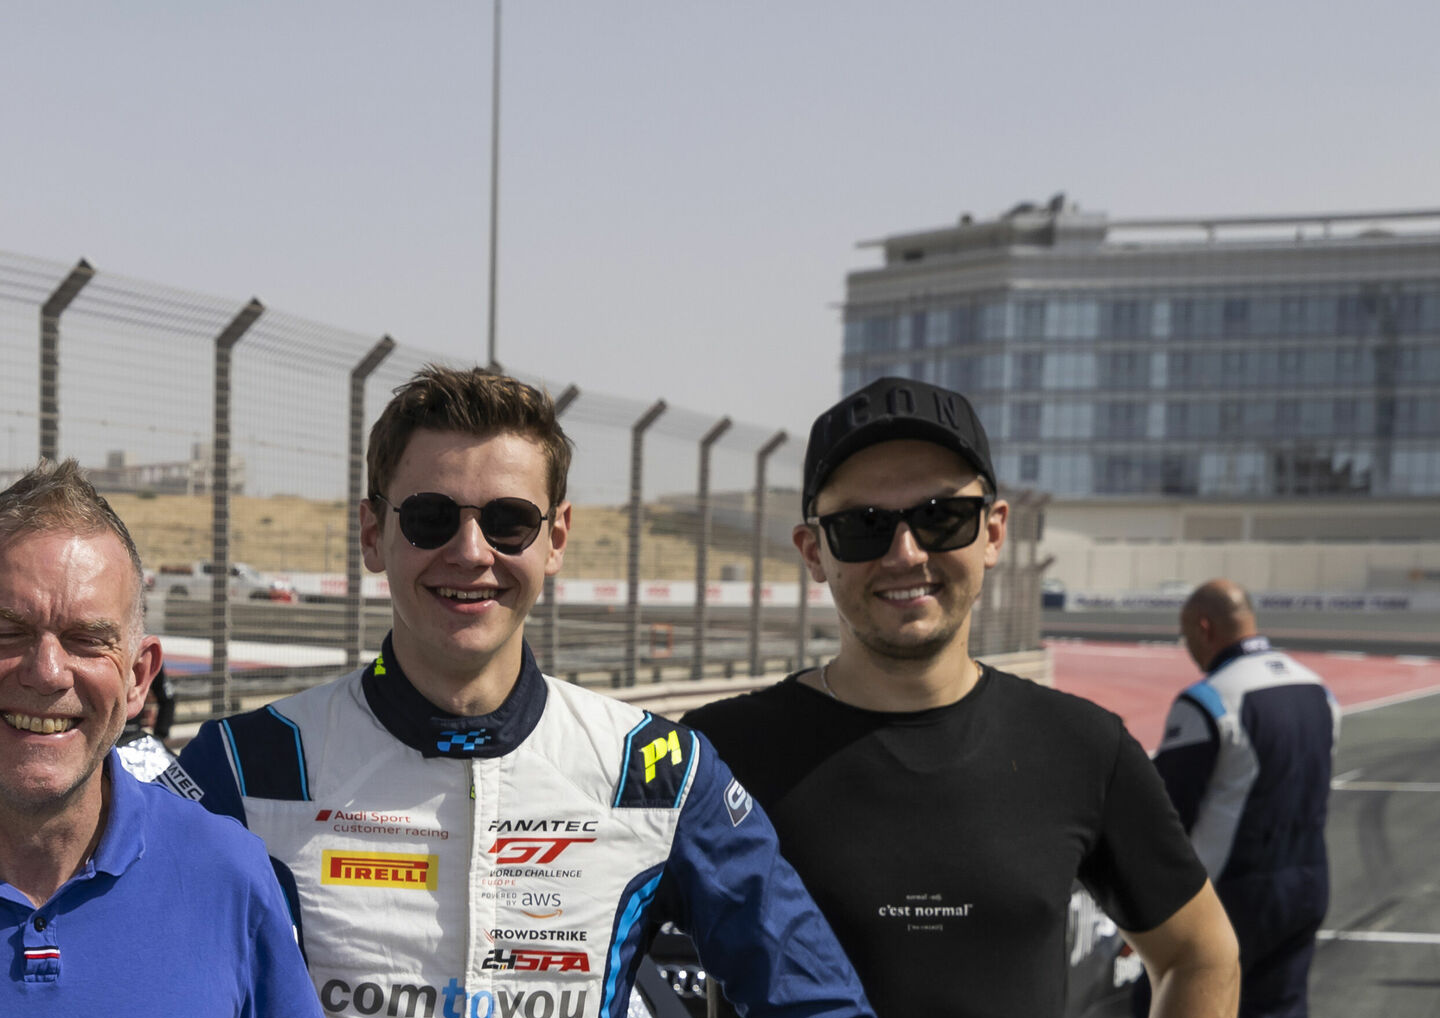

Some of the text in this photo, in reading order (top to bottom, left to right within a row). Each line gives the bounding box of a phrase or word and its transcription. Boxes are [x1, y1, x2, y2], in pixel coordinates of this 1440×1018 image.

[334, 810, 411, 824] Audi Sport
[333, 823, 449, 840] customer racing
[488, 819, 598, 832] FANATEC
[330, 856, 429, 883] PIRELLI
[524, 868, 582, 878] CHALLENGE
[521, 892, 561, 907] aws
